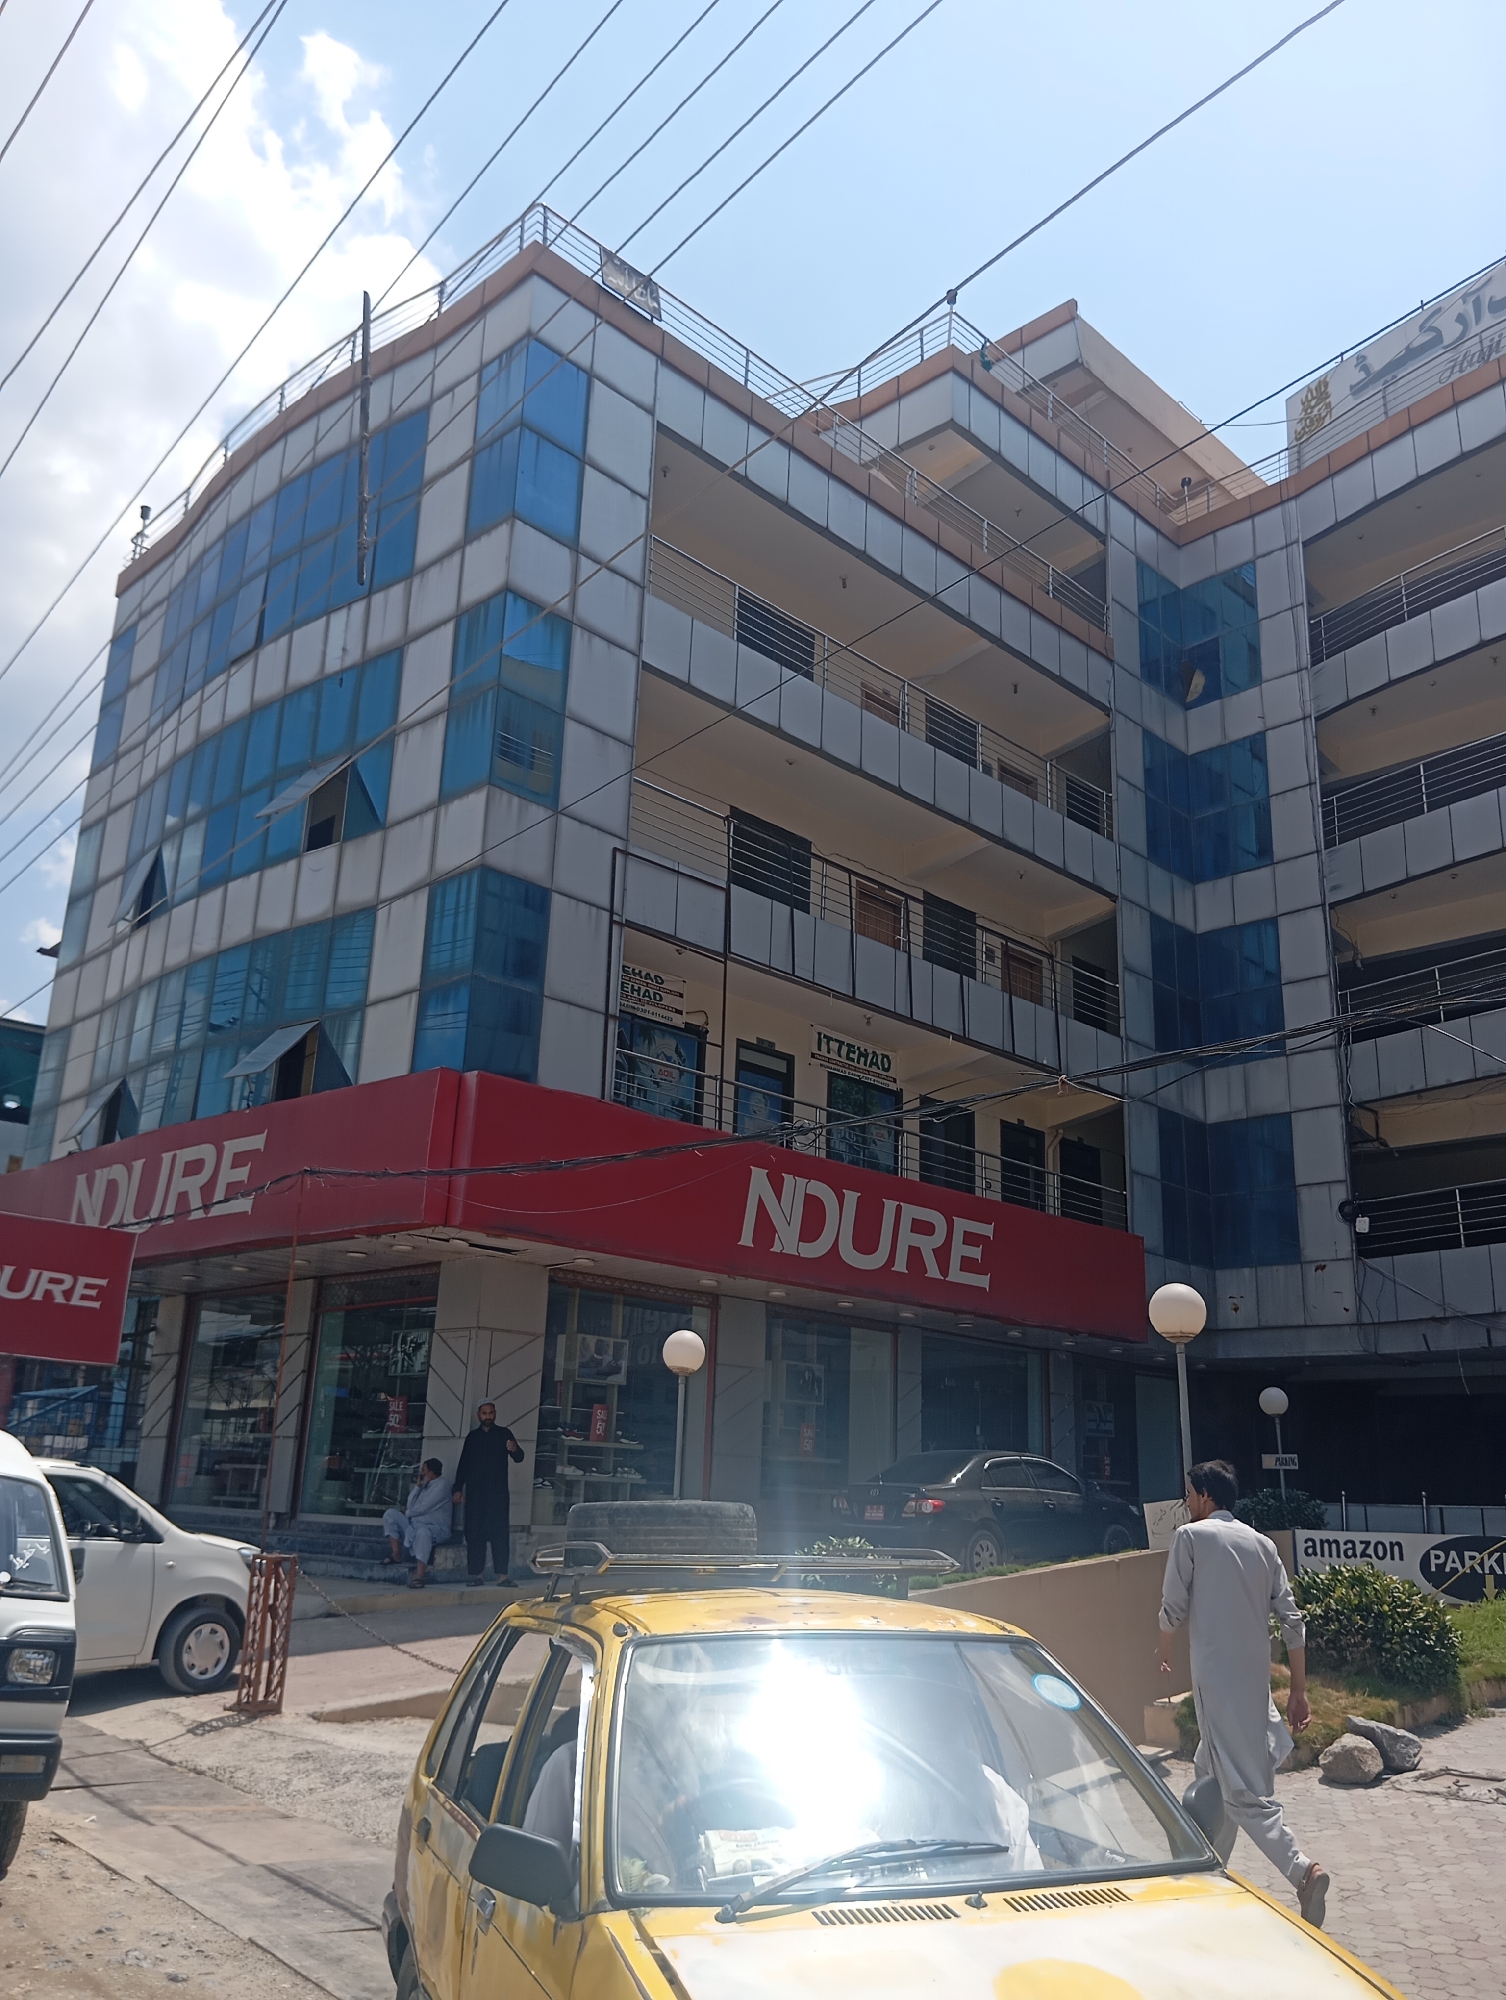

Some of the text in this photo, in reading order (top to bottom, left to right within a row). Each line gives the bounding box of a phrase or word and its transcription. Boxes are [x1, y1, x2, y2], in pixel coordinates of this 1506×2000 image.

[1439, 332, 1504, 384] Haji
[817, 1031, 892, 1073] ITTEHAD
[70, 1129, 267, 1234] NDURE
[738, 1165, 994, 1292] NDURE
[0, 1264, 109, 1310] URE
[1303, 1536, 1405, 1562] amazon
